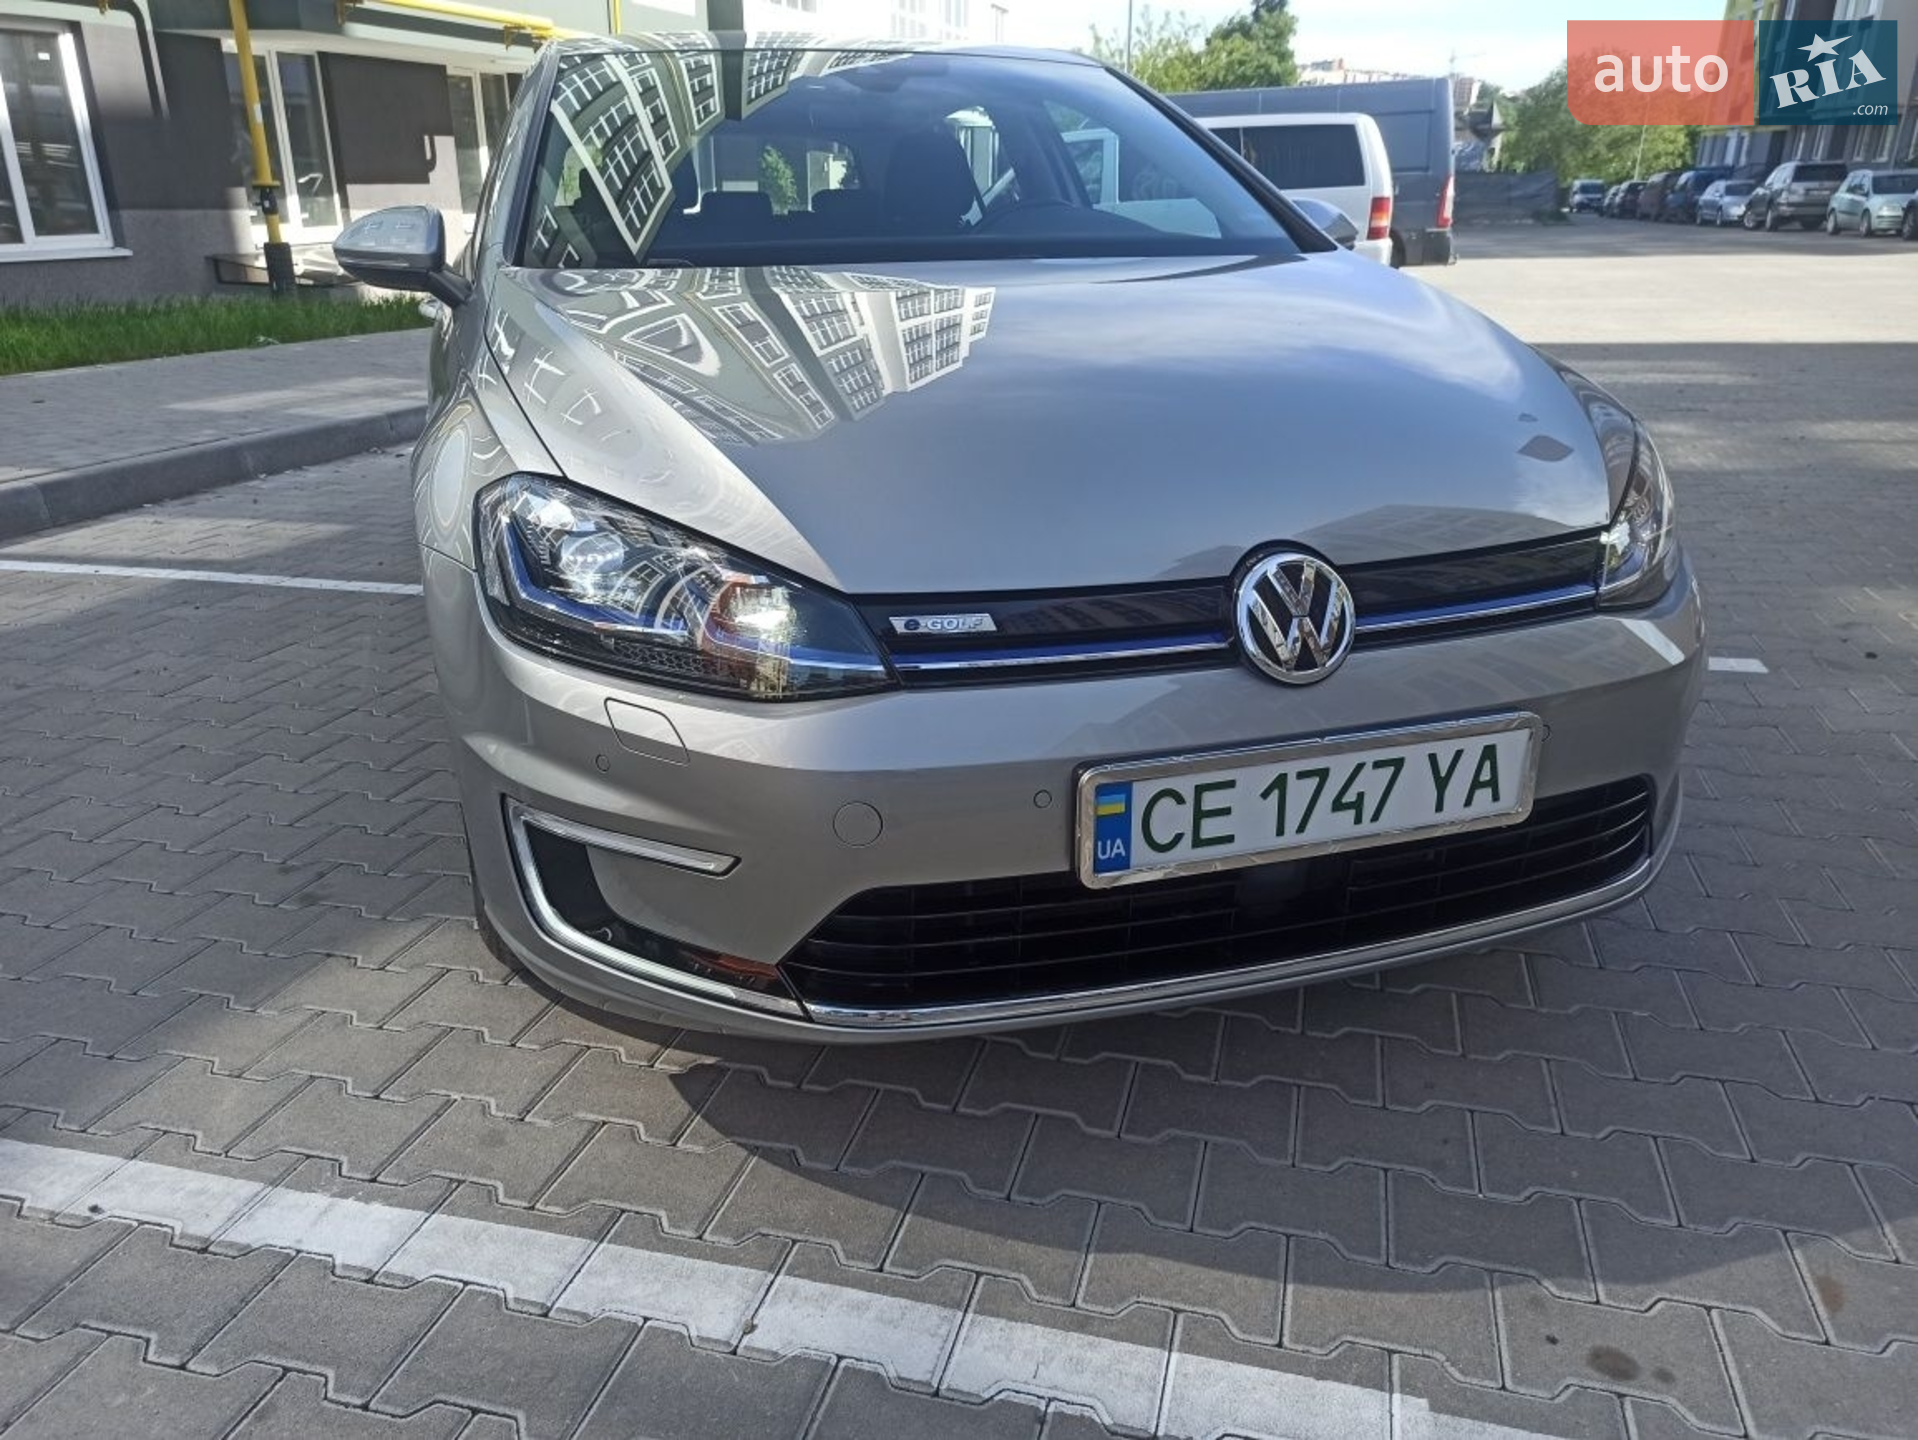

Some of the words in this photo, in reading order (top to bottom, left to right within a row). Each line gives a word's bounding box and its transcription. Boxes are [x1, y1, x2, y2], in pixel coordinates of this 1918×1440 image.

[1141, 779, 1237, 854] CE
[1260, 757, 1406, 838] 1747
[1428, 744, 1500, 813] YA
[1097, 838, 1126, 860] UA
